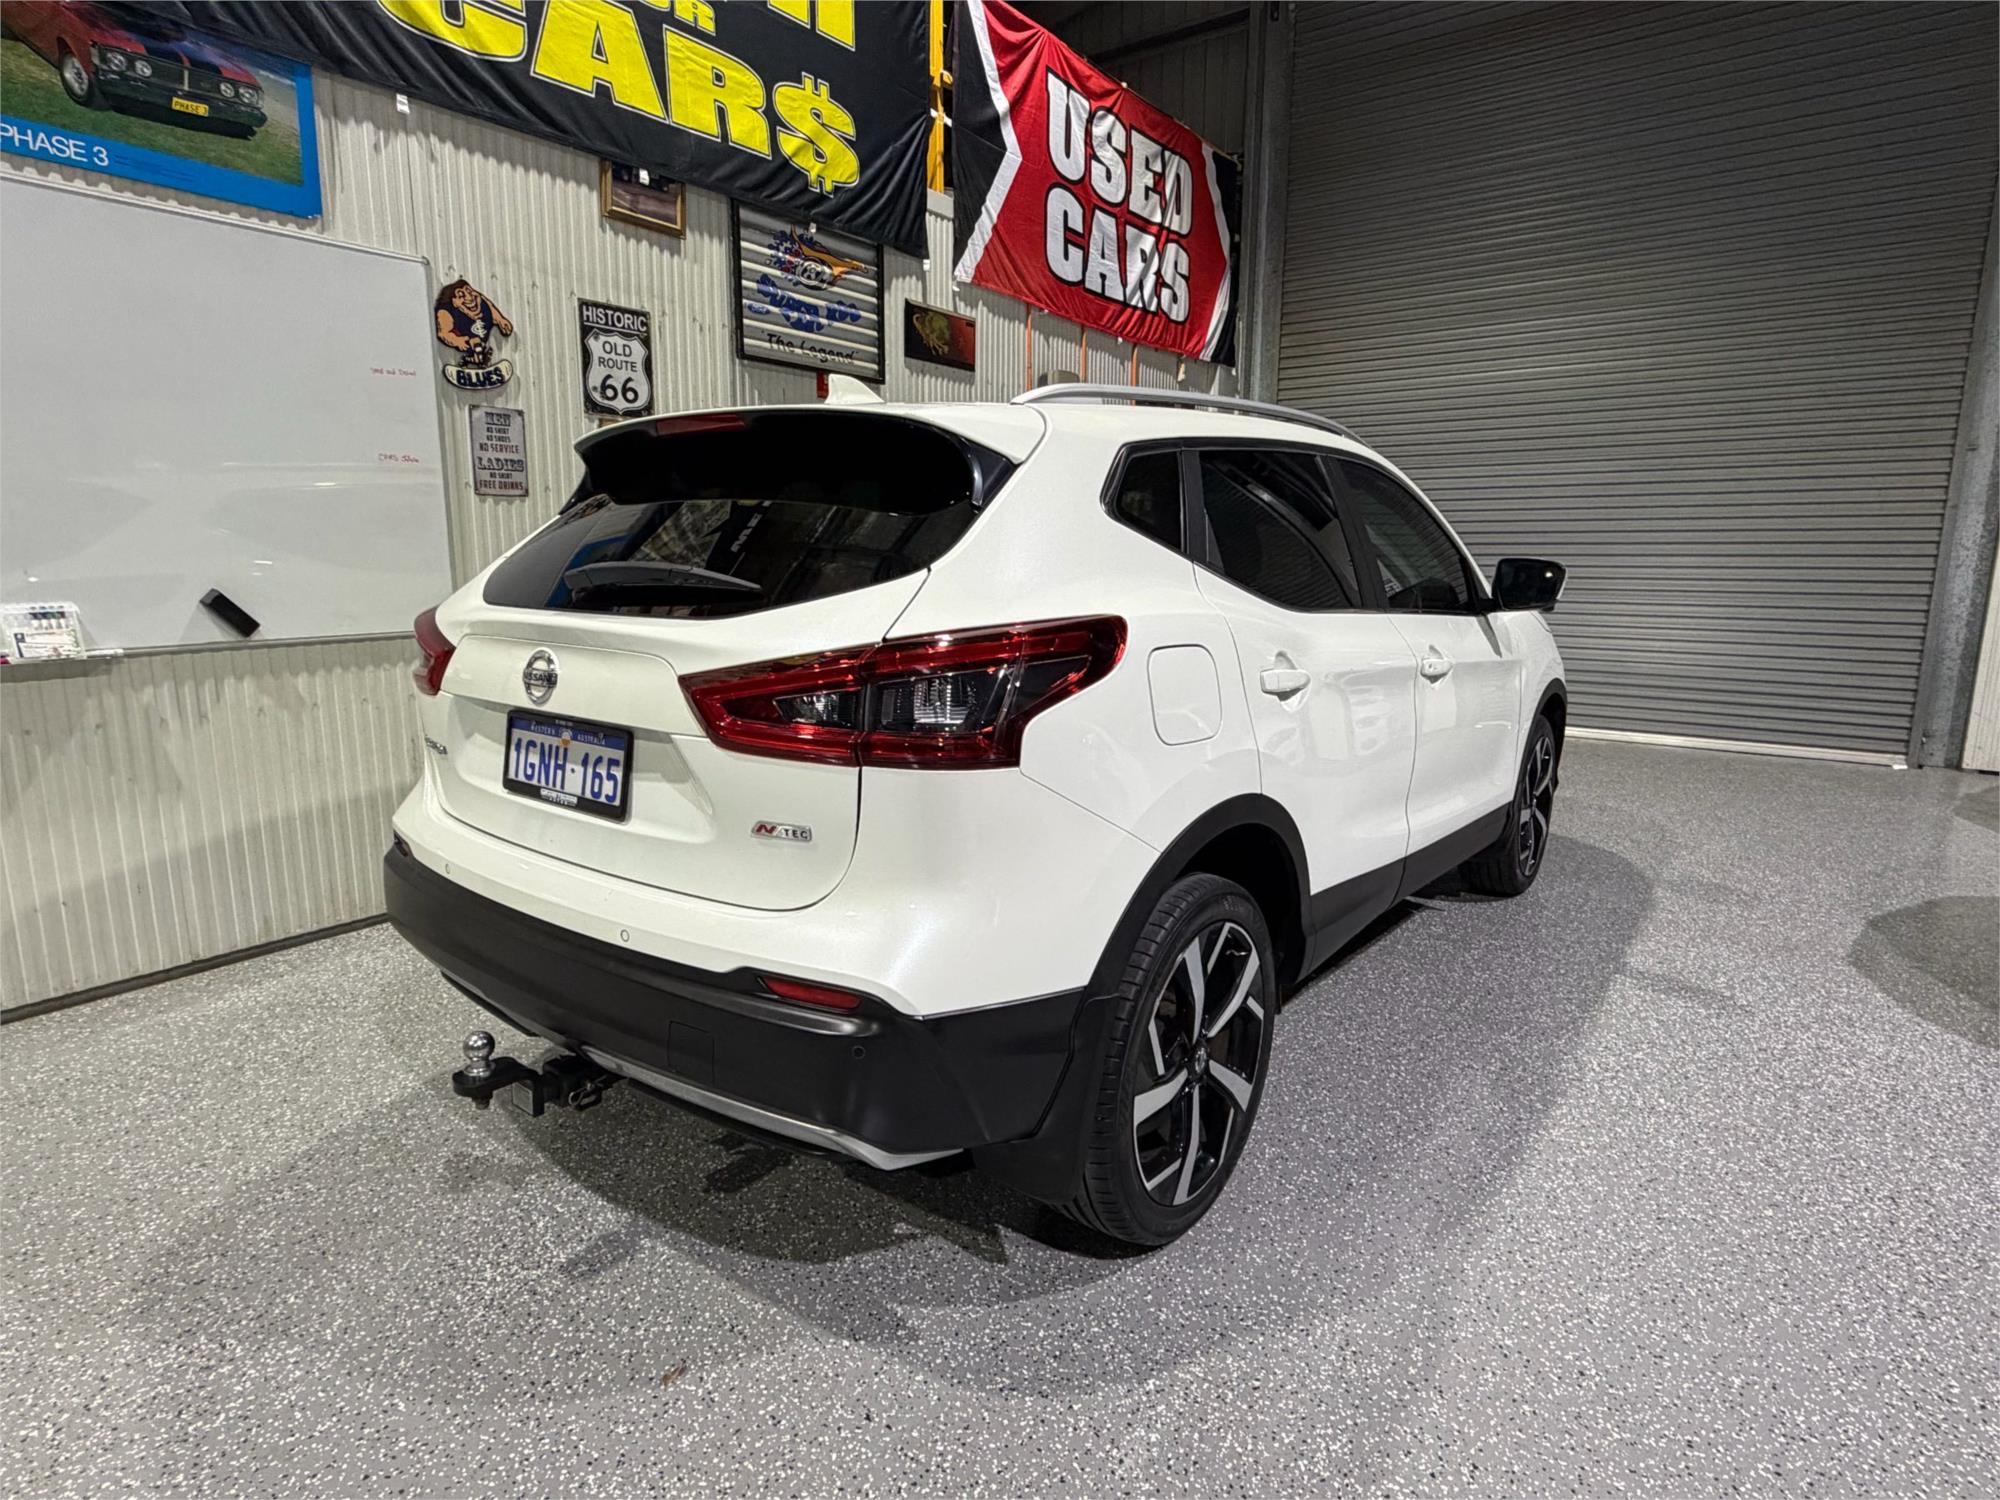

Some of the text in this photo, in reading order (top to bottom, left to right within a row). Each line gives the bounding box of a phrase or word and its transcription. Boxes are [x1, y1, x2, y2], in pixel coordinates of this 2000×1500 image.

[0, 123, 109, 166] PHASE 3
[1046, 67, 1193, 238] USED
[1046, 185, 1190, 323] CARS
[582, 305, 648, 332] HISTORIC
[602, 340, 633, 358] OLD
[598, 357, 638, 373] ROUTE
[456, 367, 506, 387] BLUES
[600, 374, 639, 404] 66
[494, 427, 510, 435] SHIRT
[494, 435, 511, 443] SHOES
[479, 442, 520, 454] NO SERVICE
[476, 456, 525, 472] LADIES
[479, 479, 524, 491] FREE DRINKS
[497, 472, 513, 480] SHIRT
[531, 722, 556, 735] WESTERN
[577, 733, 607, 746] AUSTRALIA
